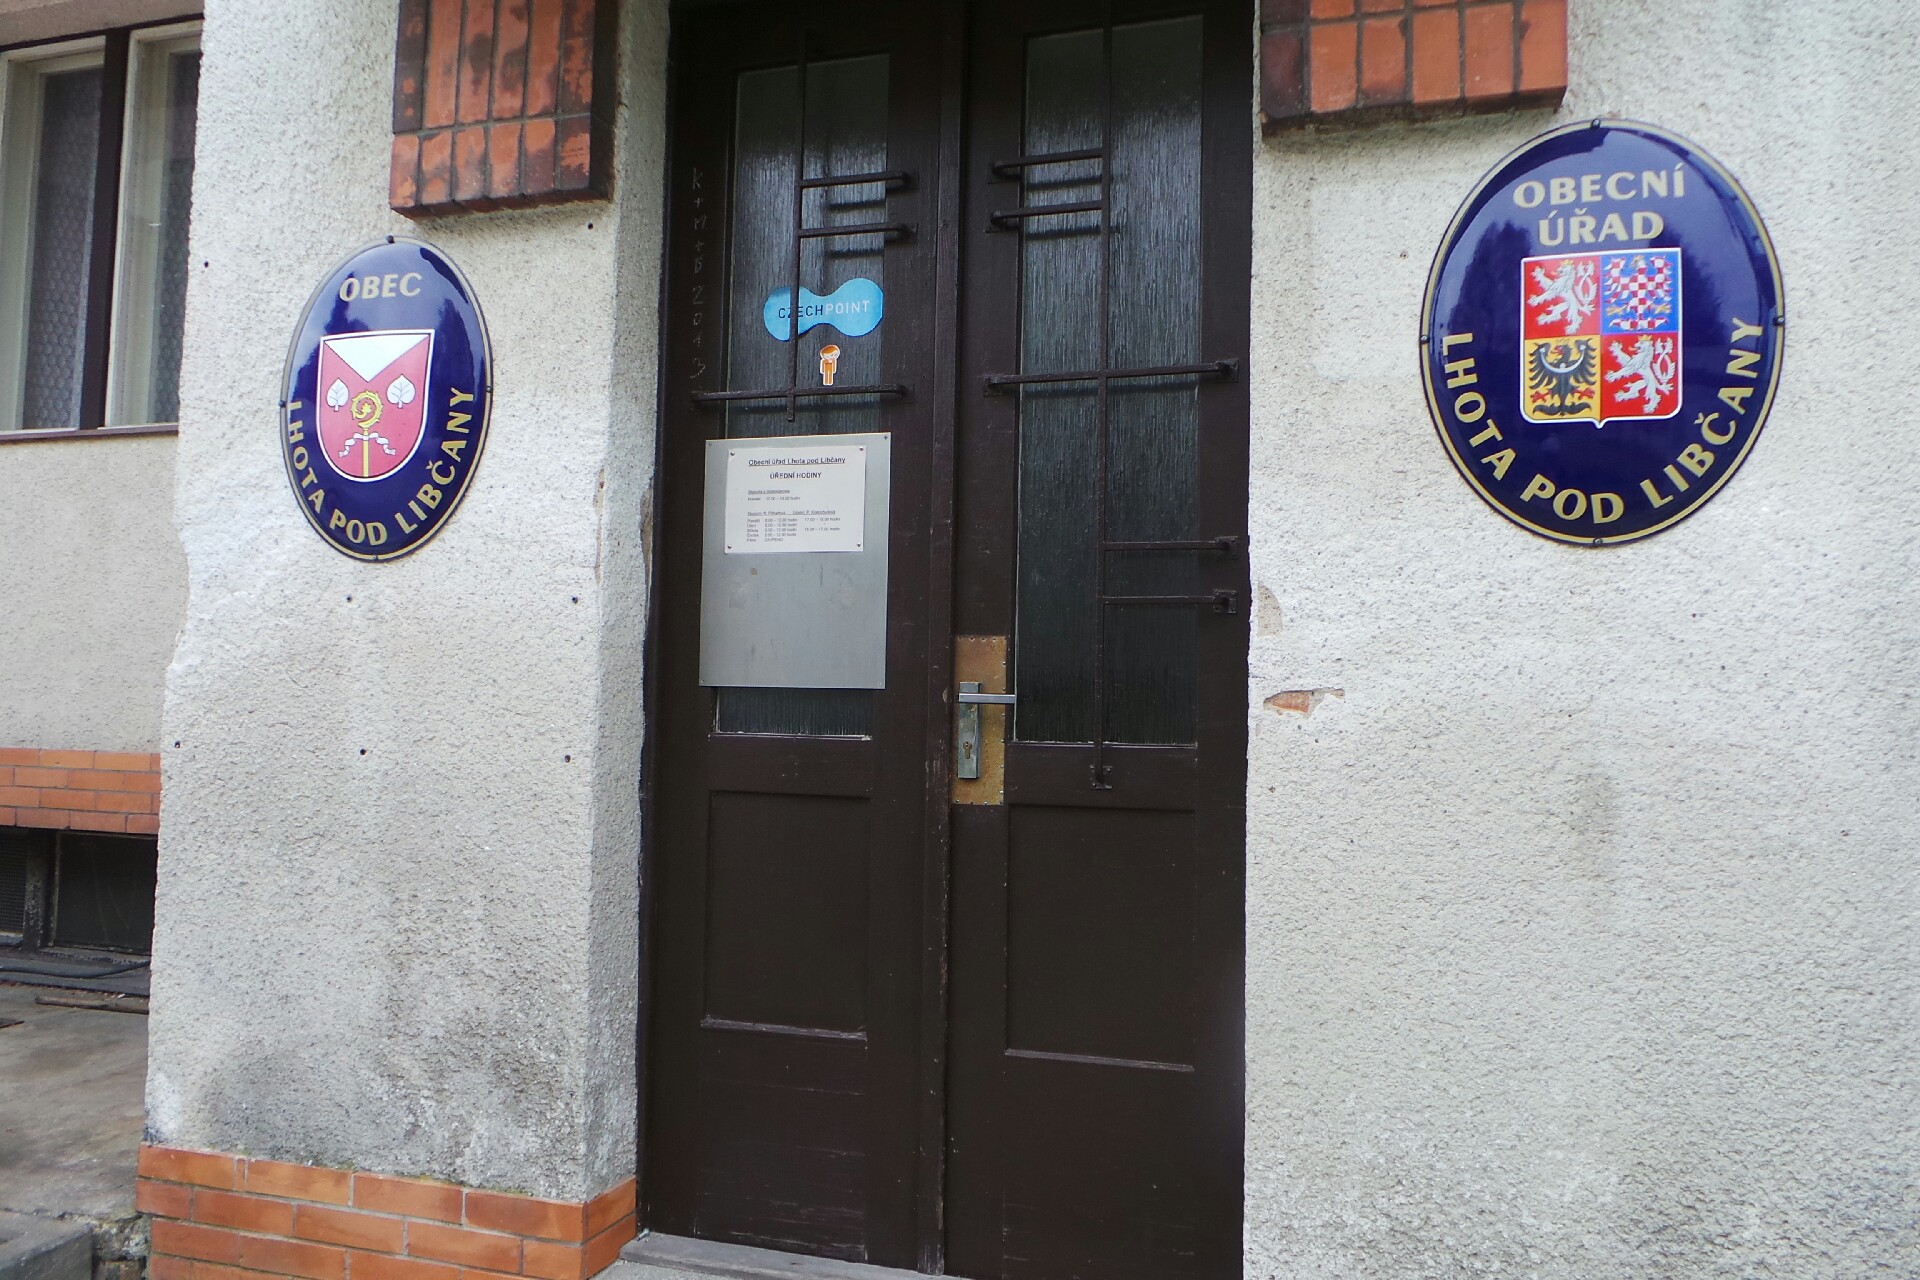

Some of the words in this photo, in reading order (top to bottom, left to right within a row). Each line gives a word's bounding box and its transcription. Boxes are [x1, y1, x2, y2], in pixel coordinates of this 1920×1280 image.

[1513, 163, 1685, 208] OBECNÍ
[1538, 208, 1664, 246] ÚŘAD
[339, 272, 423, 302] OBEC
[1442, 332, 1516, 481] LHOTA
[1519, 473, 1625, 525] POD
[1639, 317, 1764, 510] LIBČANY
[286, 401, 325, 514] LHOTA
[328, 511, 388, 547] POD
[394, 387, 474, 535] LIBČANY
[796, 471, 822, 479] HODINY
